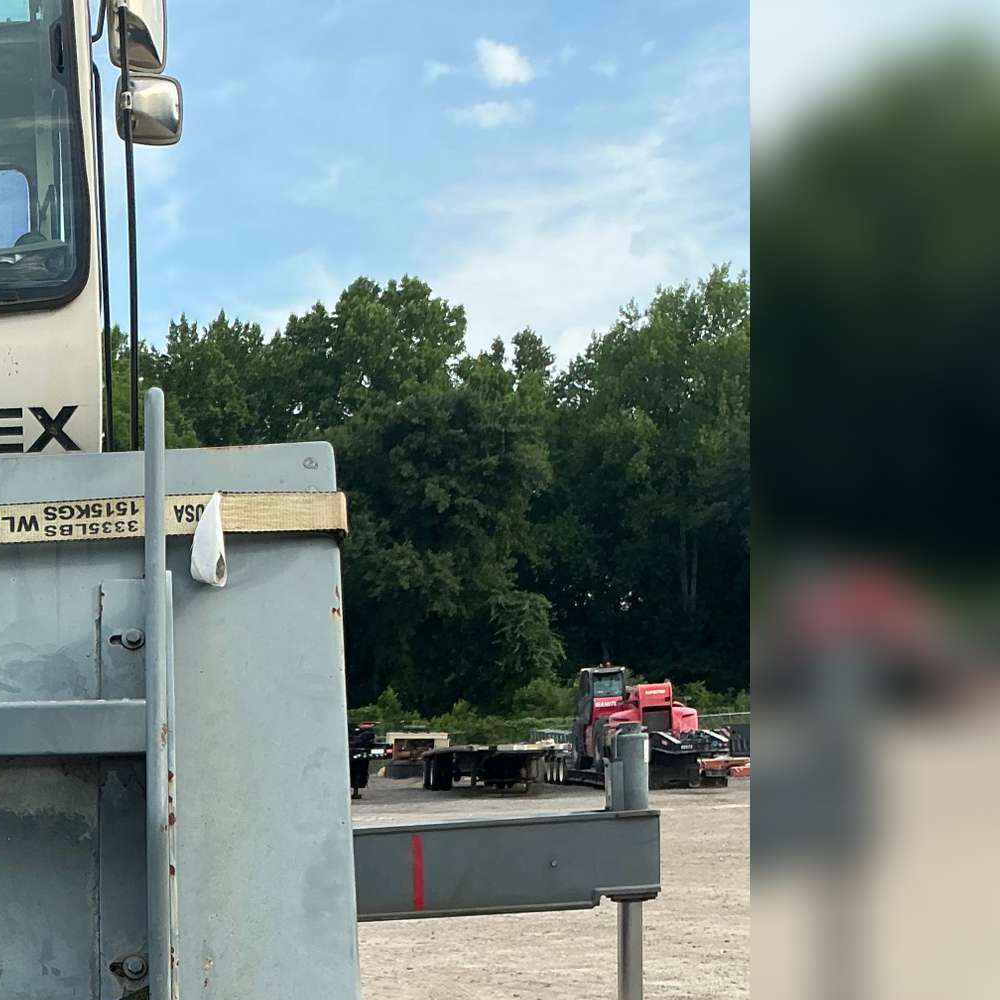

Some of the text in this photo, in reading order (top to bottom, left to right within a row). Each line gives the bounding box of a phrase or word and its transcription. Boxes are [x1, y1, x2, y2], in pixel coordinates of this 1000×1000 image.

[43, 501, 139, 521] 1515KGS
[173, 503, 204, 523] USA
[44, 520, 138, 537] 3335LBS
